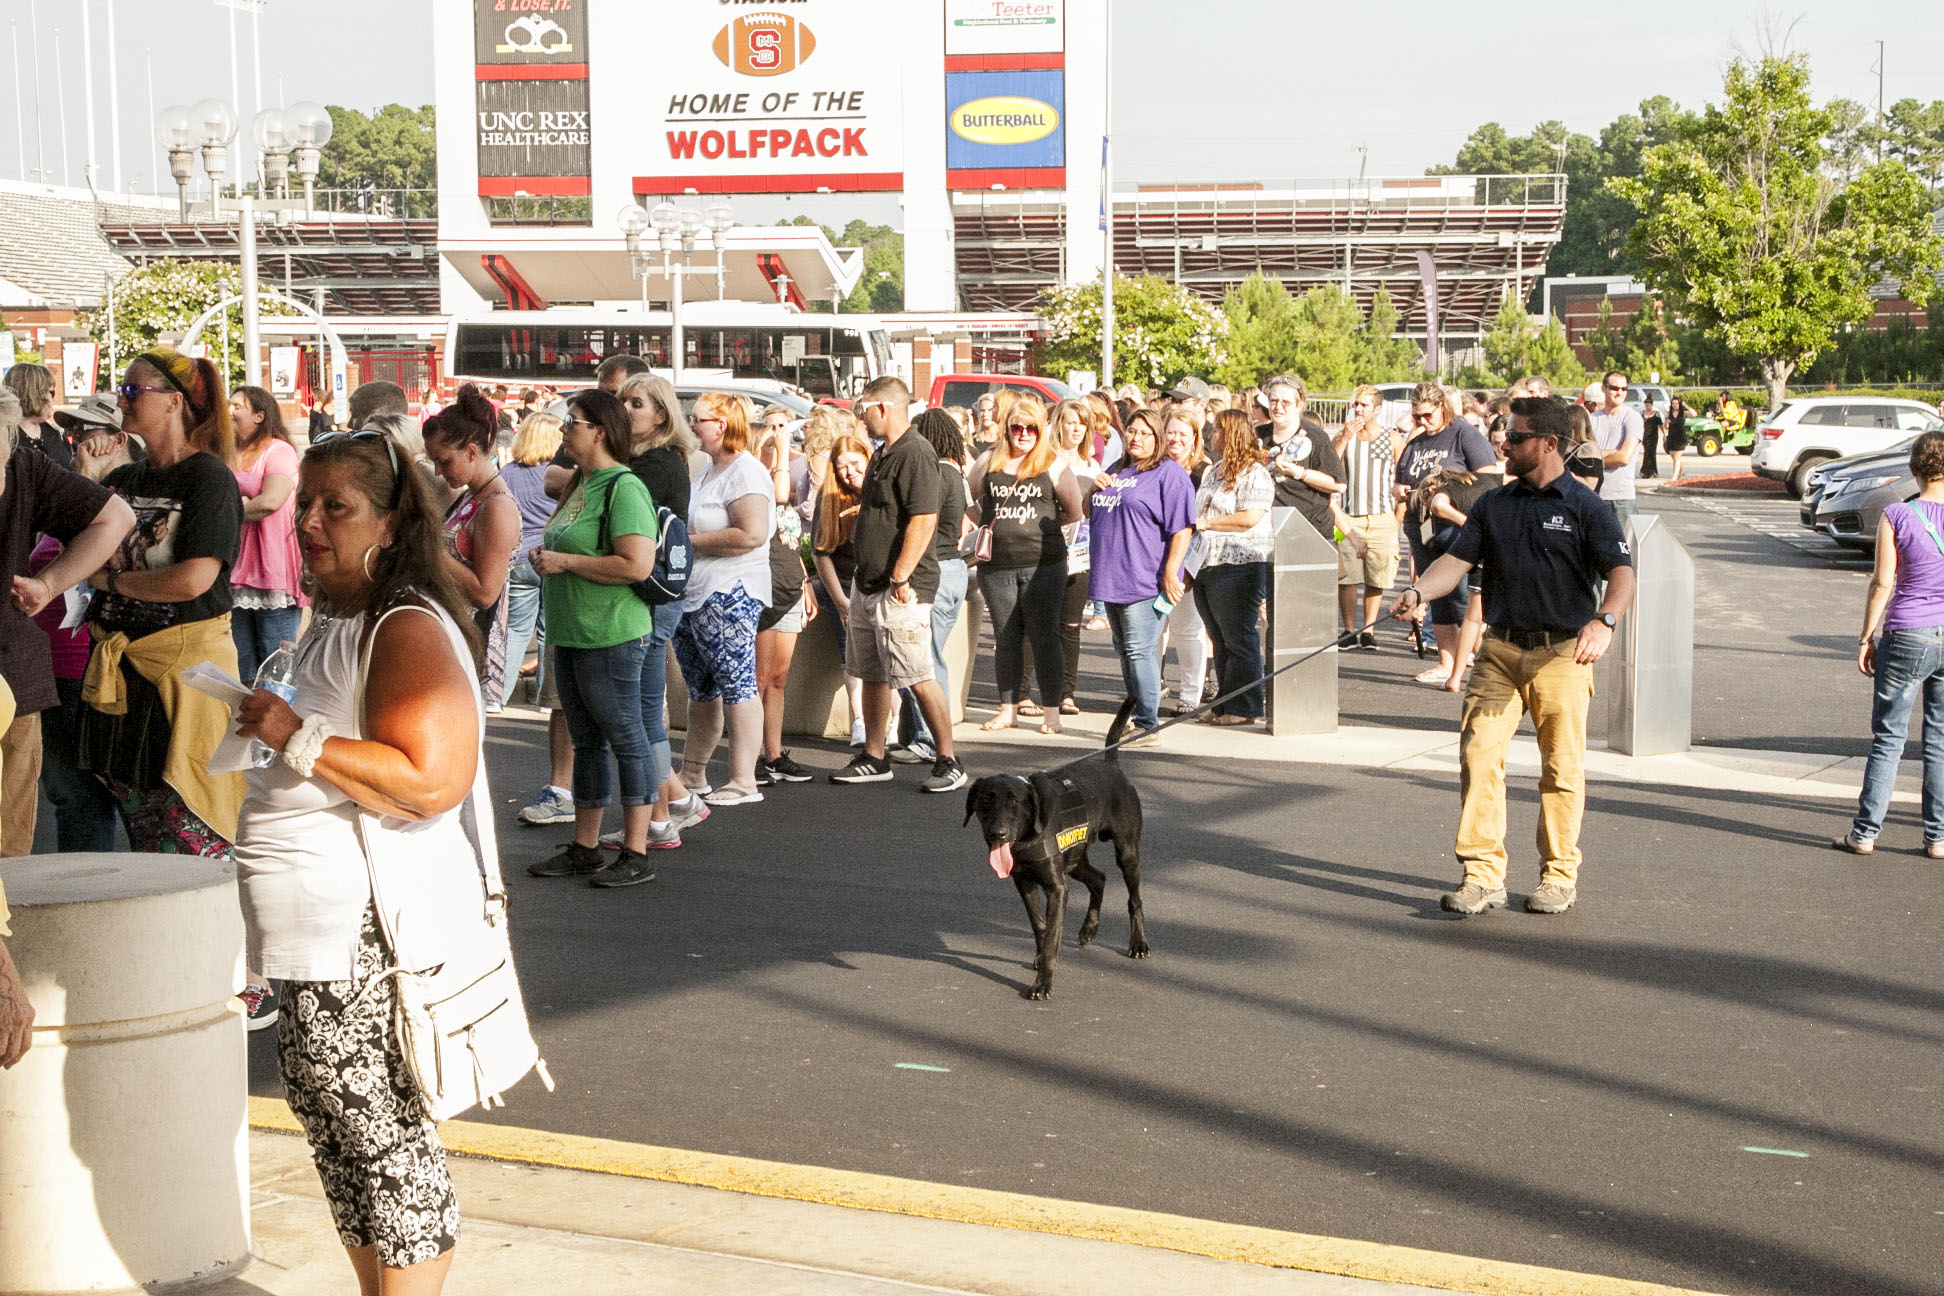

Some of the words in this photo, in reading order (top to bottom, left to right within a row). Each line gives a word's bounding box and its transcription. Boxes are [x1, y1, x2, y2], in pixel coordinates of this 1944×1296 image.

[992, 2, 1054, 17] Teeter
[668, 93, 750, 115] HOME
[761, 92, 800, 113] OF
[812, 91, 865, 112] THE
[479, 111, 534, 131] UNC
[539, 111, 589, 130] REX
[963, 113, 1047, 128] BUTTERBALL
[480, 131, 590, 146] HEALTHCARE
[666, 127, 869, 160] WOLFPACK
[989, 481, 1043, 503] hangin
[1092, 492, 1122, 513] tough
[994, 502, 1038, 525] tough
[1551, 515, 1564, 525] K2
[1075, 826, 1088, 841] PET
